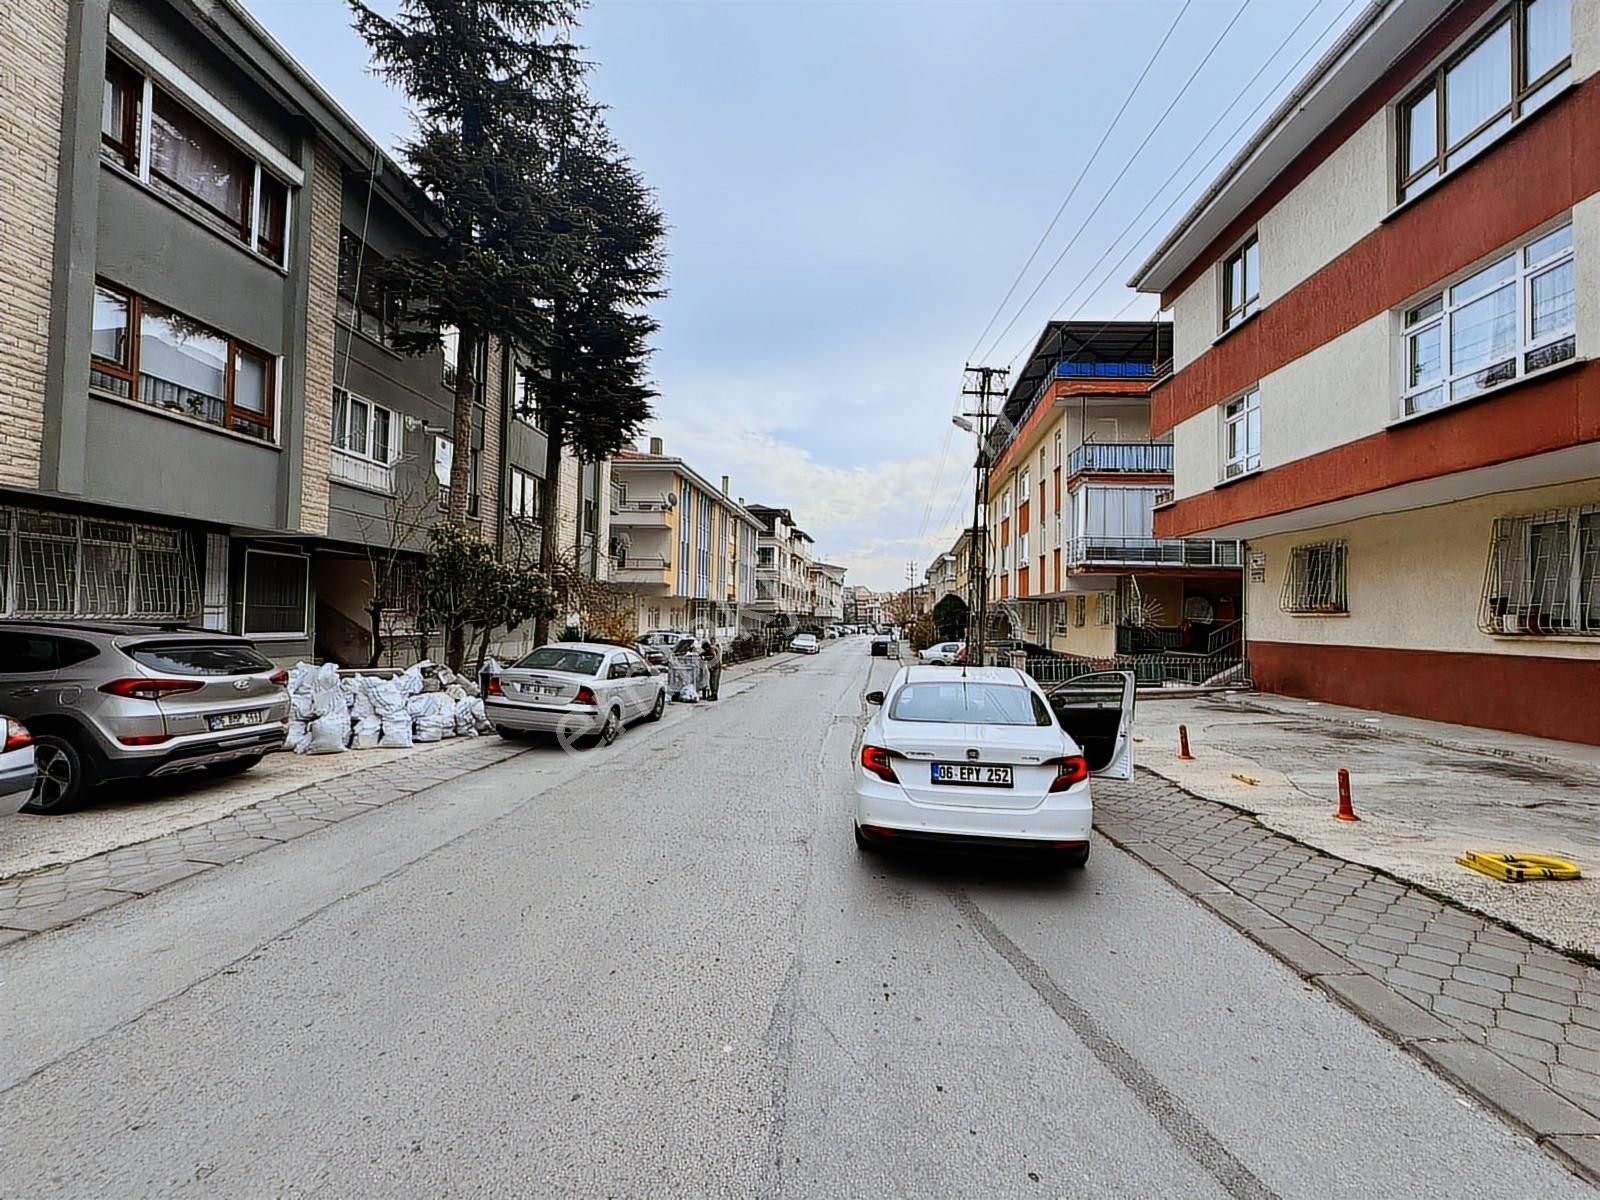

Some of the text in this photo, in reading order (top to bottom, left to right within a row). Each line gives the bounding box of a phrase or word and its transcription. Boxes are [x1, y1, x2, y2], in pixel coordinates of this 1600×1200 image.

[939, 766, 1009, 783] 06 EPY 252
